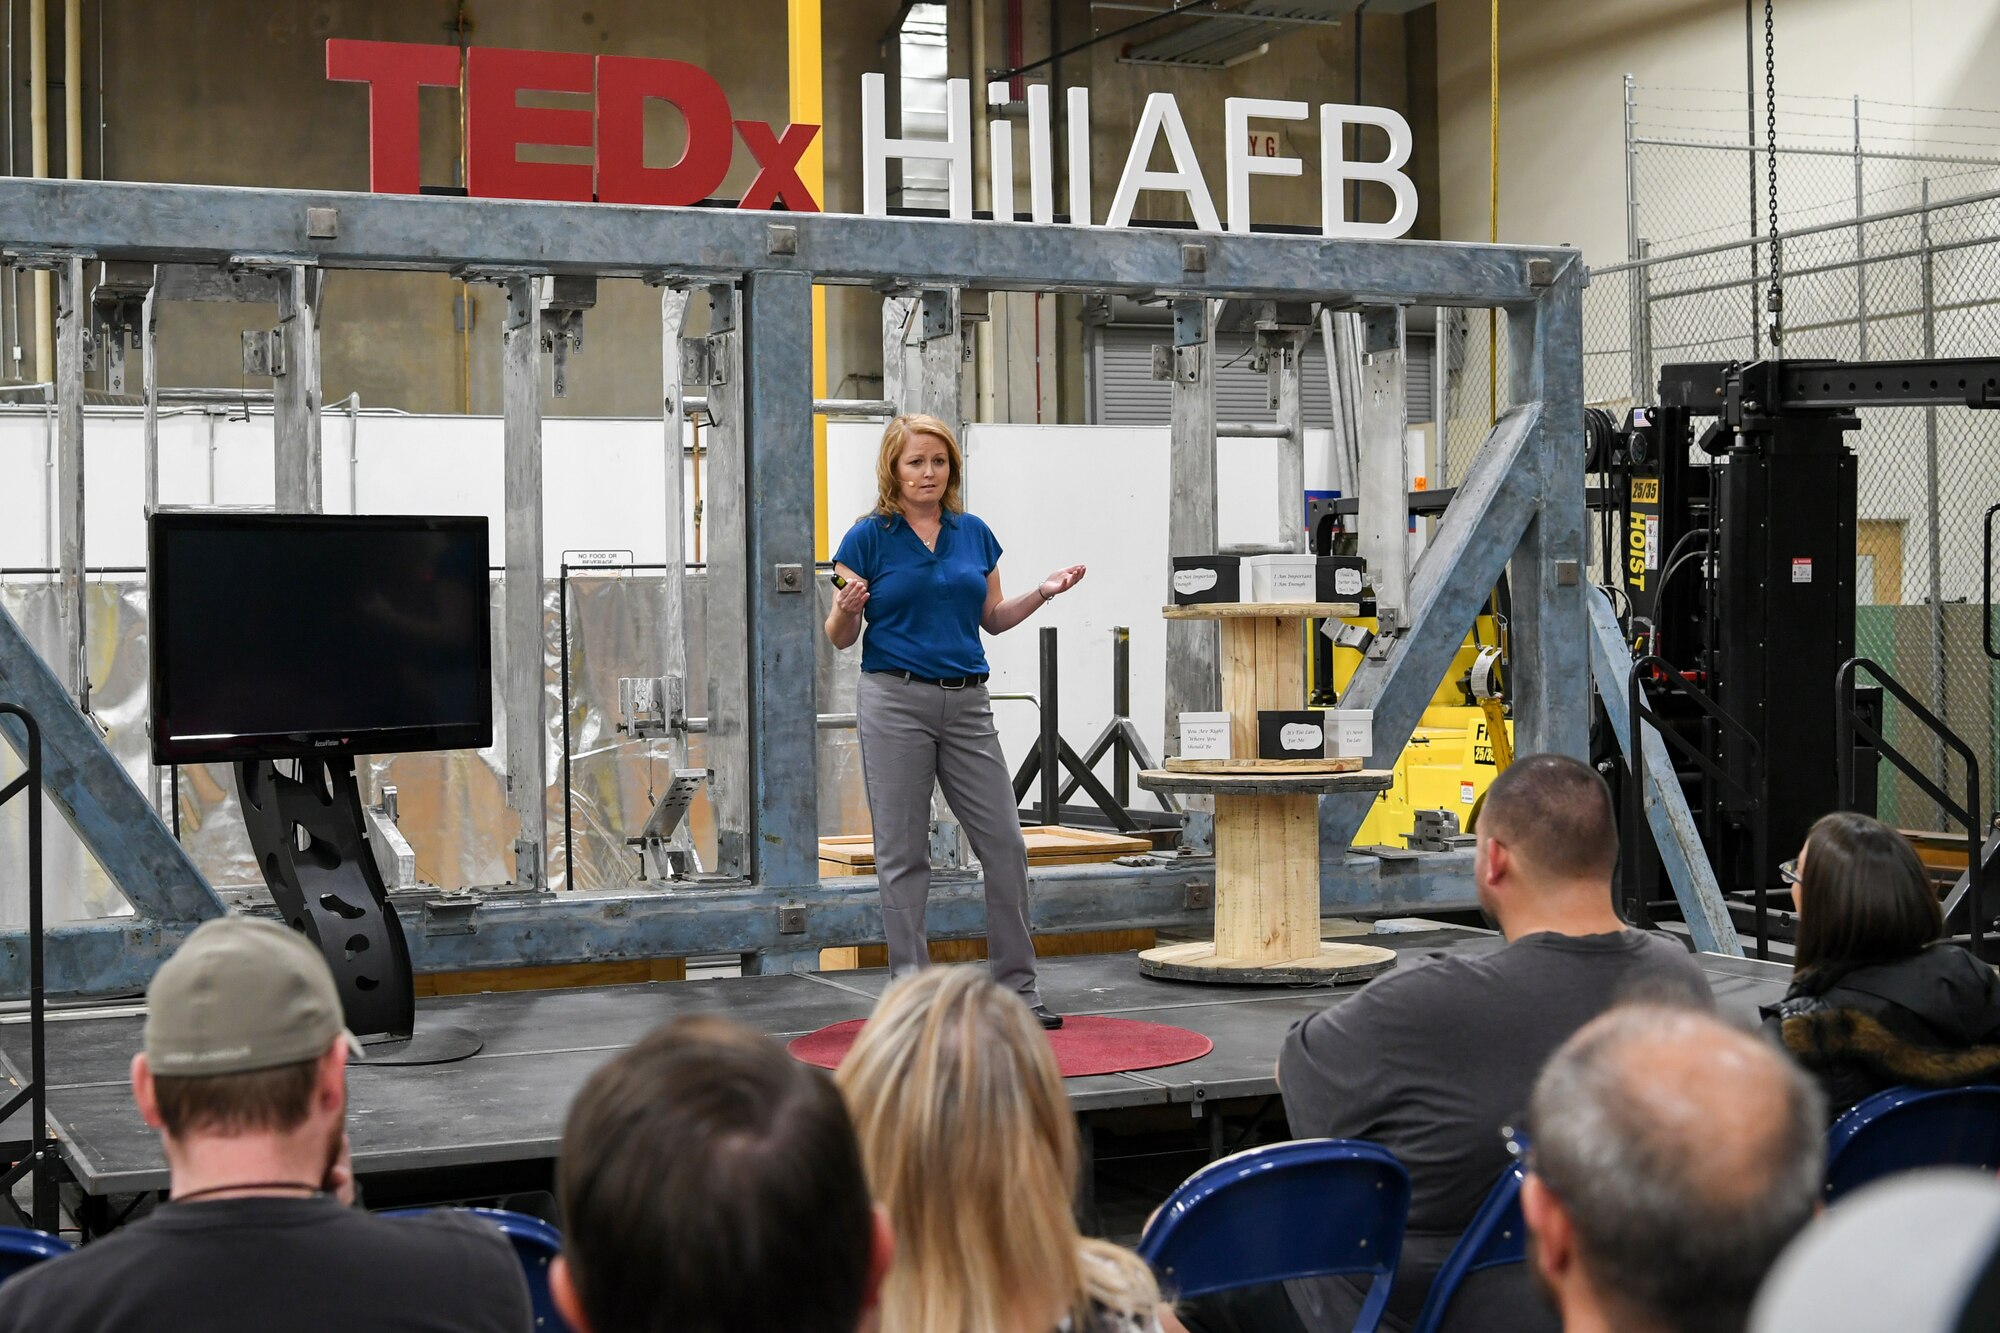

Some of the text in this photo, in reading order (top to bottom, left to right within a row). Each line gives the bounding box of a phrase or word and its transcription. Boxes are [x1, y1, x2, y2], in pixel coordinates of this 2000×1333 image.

[326, 38, 1418, 239] TEDx HillAFB
[1632, 482, 1657, 499] 25/35
[1630, 512, 1646, 592] HOIST
